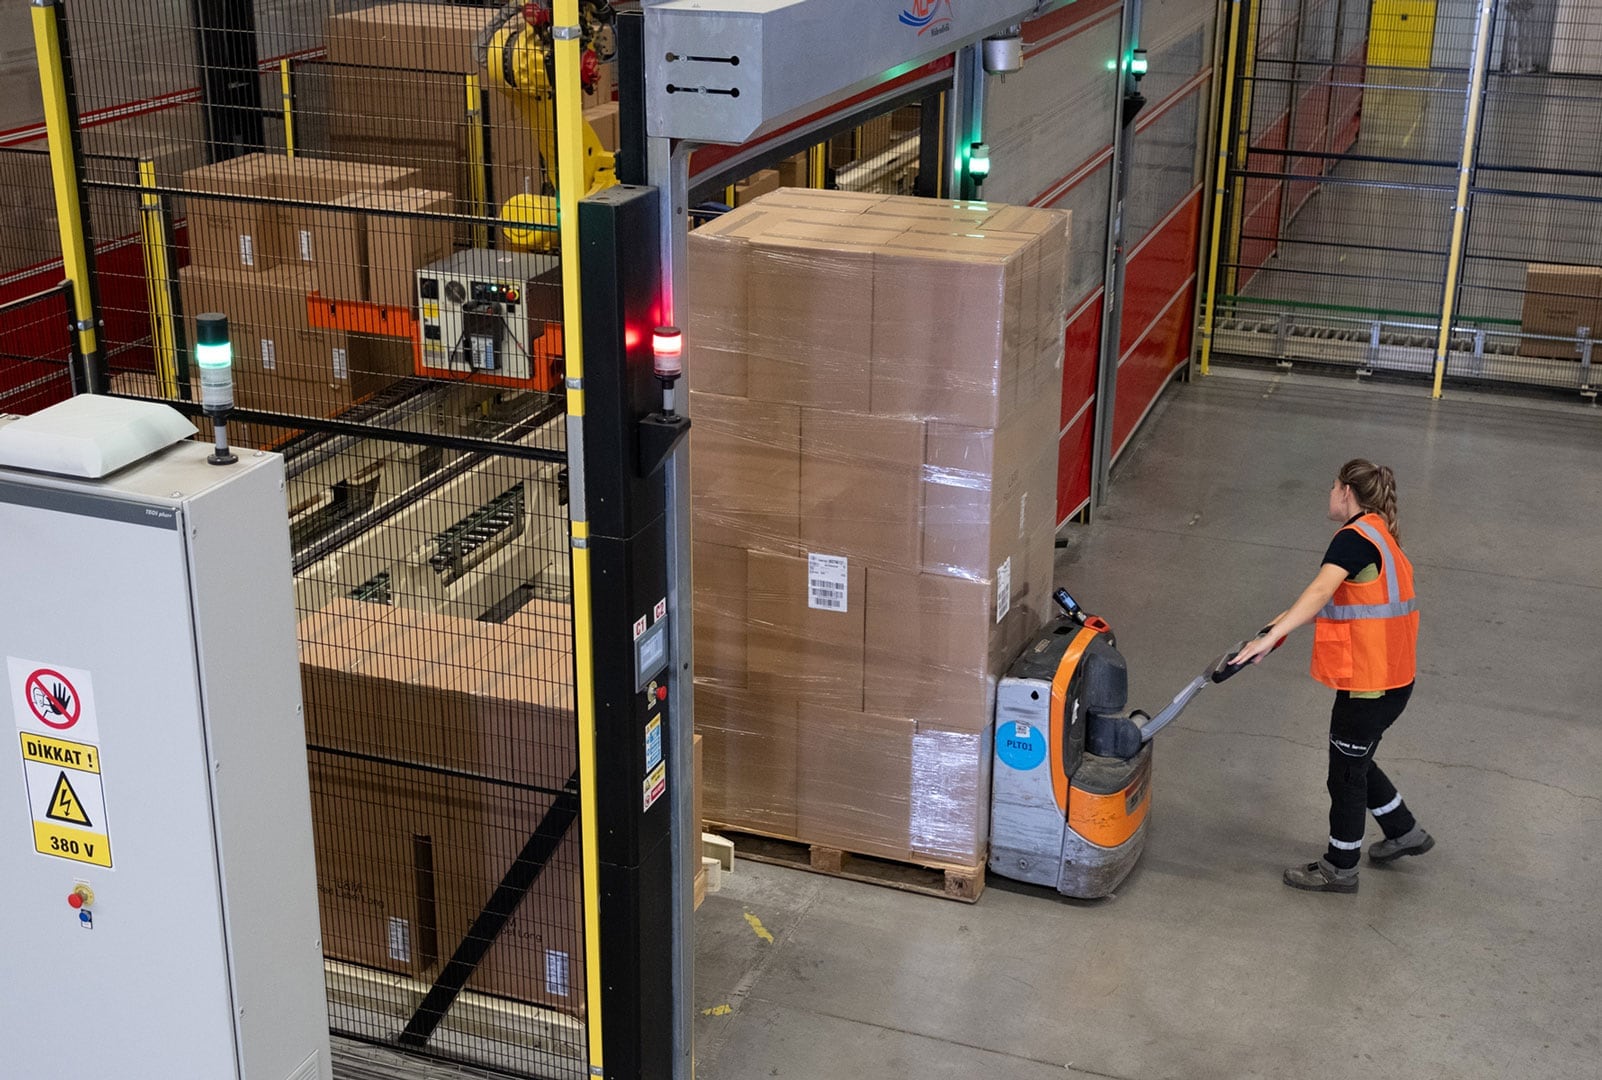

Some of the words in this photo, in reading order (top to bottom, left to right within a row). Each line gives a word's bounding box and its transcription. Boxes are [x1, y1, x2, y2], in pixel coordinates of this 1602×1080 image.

[655, 602, 664, 619] C2
[635, 618, 645, 636] C1
[27, 740, 82, 765] DİKKAT
[87, 753, 93, 768] !
[50, 835, 80, 855] 380
[84, 842, 94, 858] V
